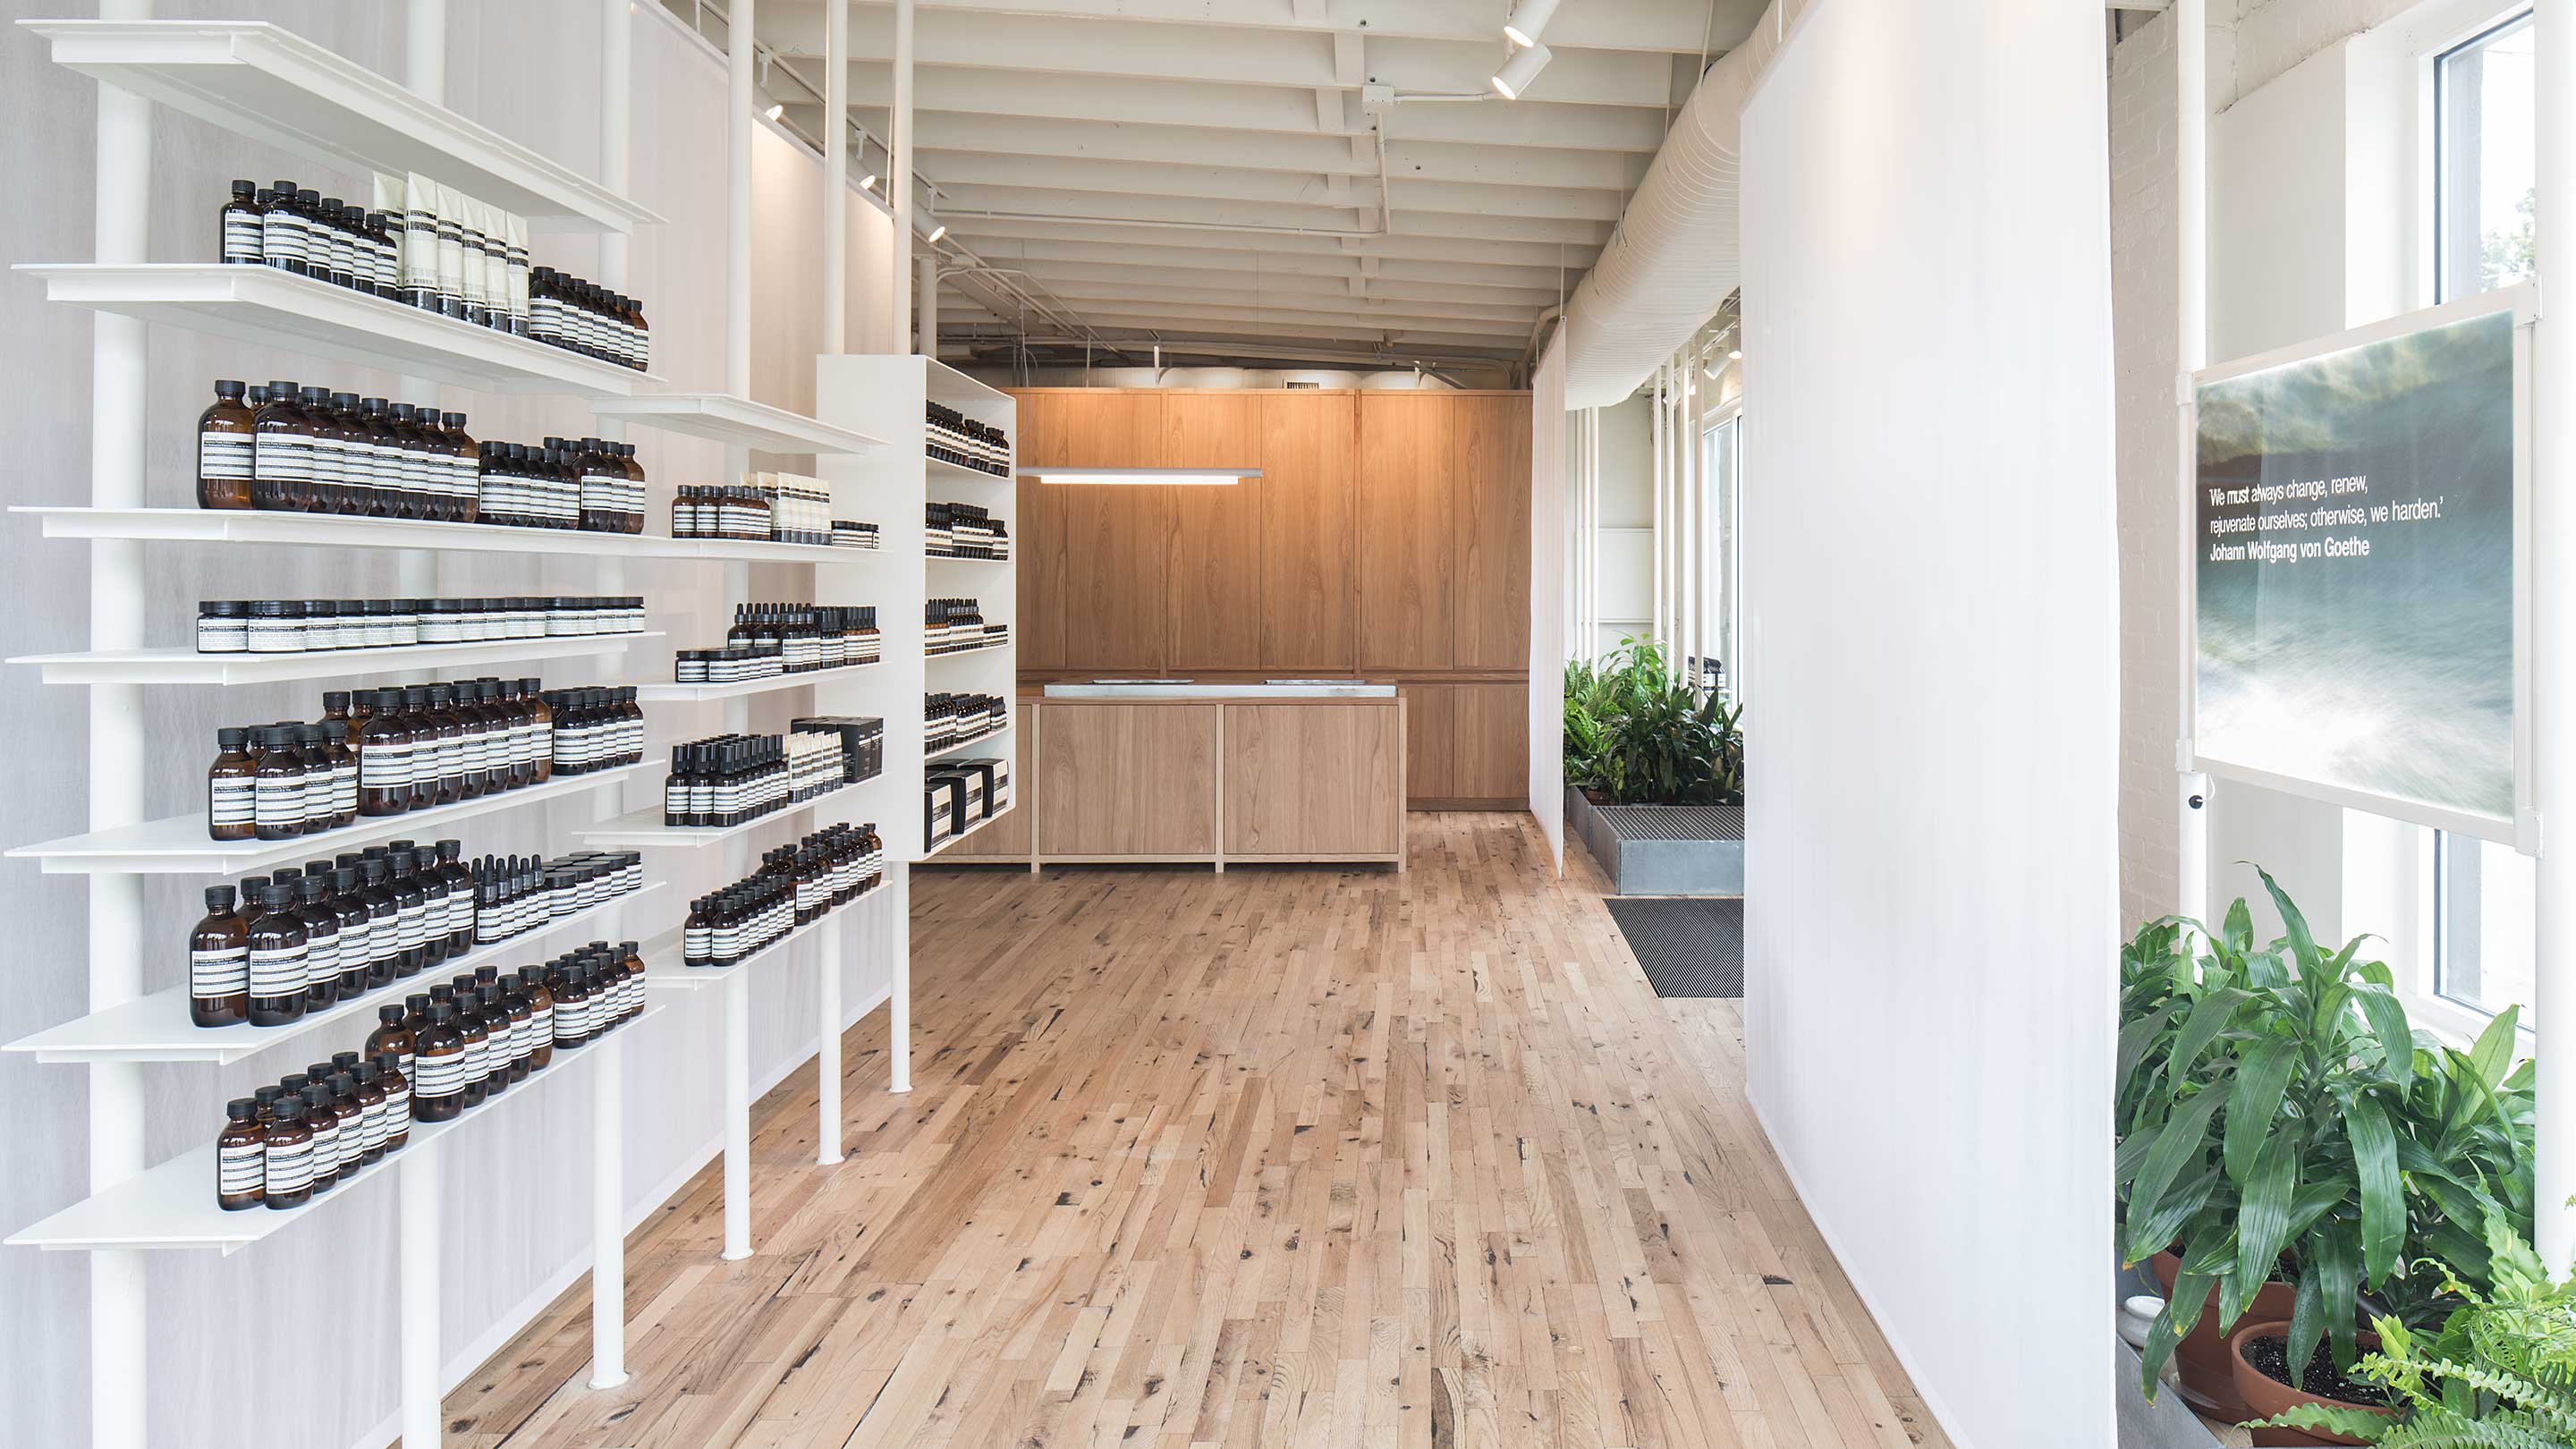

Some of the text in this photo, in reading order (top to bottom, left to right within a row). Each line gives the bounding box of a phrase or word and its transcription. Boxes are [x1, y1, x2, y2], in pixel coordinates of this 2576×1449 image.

[2226, 485, 2250, 505] must
[2251, 483, 2284, 505] always
[2286, 479, 2327, 502] change,
[2332, 475, 2368, 495] renew,
[2210, 496, 2444, 538] rejuvenate ourselves; otherwise, we harden.'
[2209, 535, 2370, 564] Johann Wolfgang von Goethe
